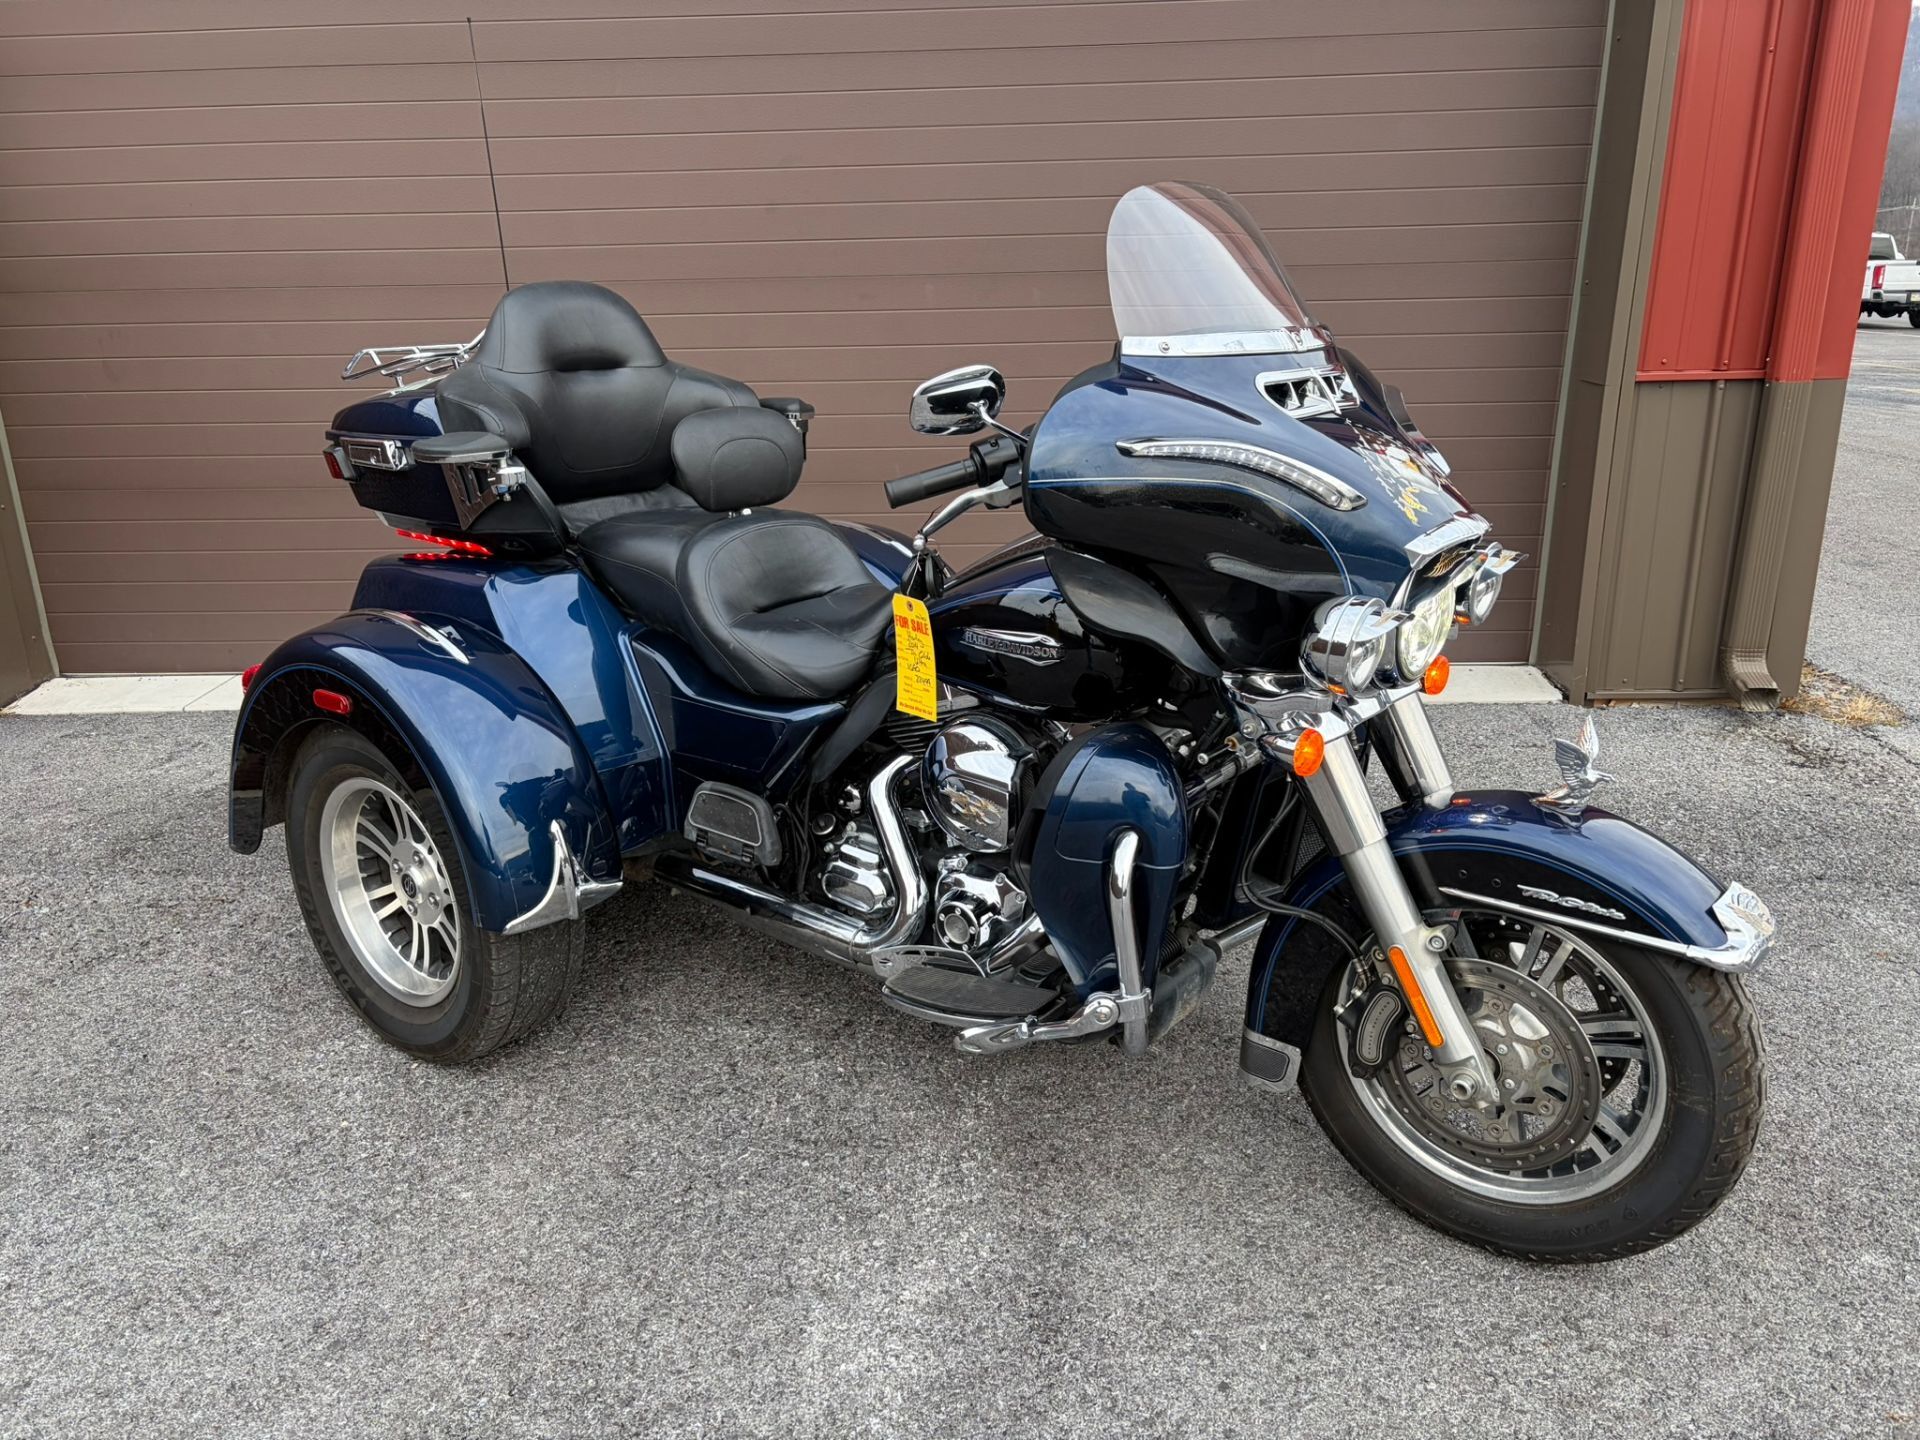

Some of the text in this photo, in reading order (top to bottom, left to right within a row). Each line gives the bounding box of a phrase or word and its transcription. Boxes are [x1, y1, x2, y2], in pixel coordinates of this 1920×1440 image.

[895, 614, 910, 629] FOR
[910, 618, 930, 636] SALE
[964, 630, 1059, 658] HARLEY-DAVIDSON
[299, 883, 358, 992] DUNLOP
